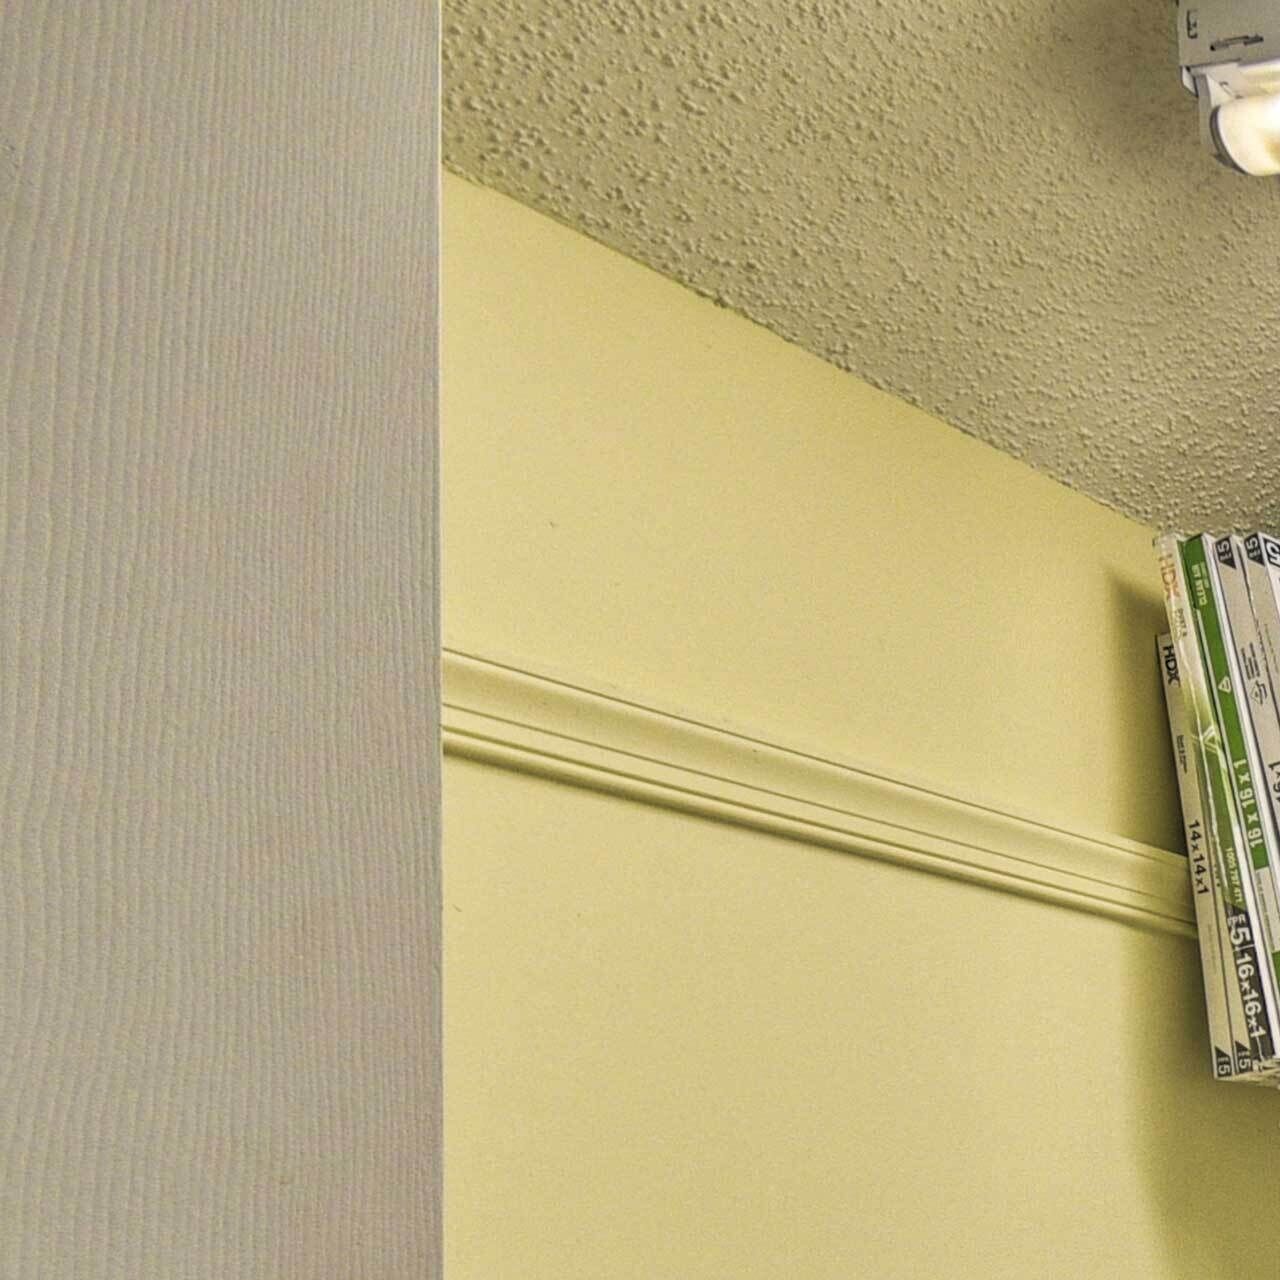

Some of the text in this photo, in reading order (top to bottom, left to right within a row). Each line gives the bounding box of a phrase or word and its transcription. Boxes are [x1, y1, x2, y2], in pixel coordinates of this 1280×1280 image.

[1159, 553, 1181, 600] HDX
[1163, 644, 1181, 687] HDX
[1230, 929, 1251, 946] 5
